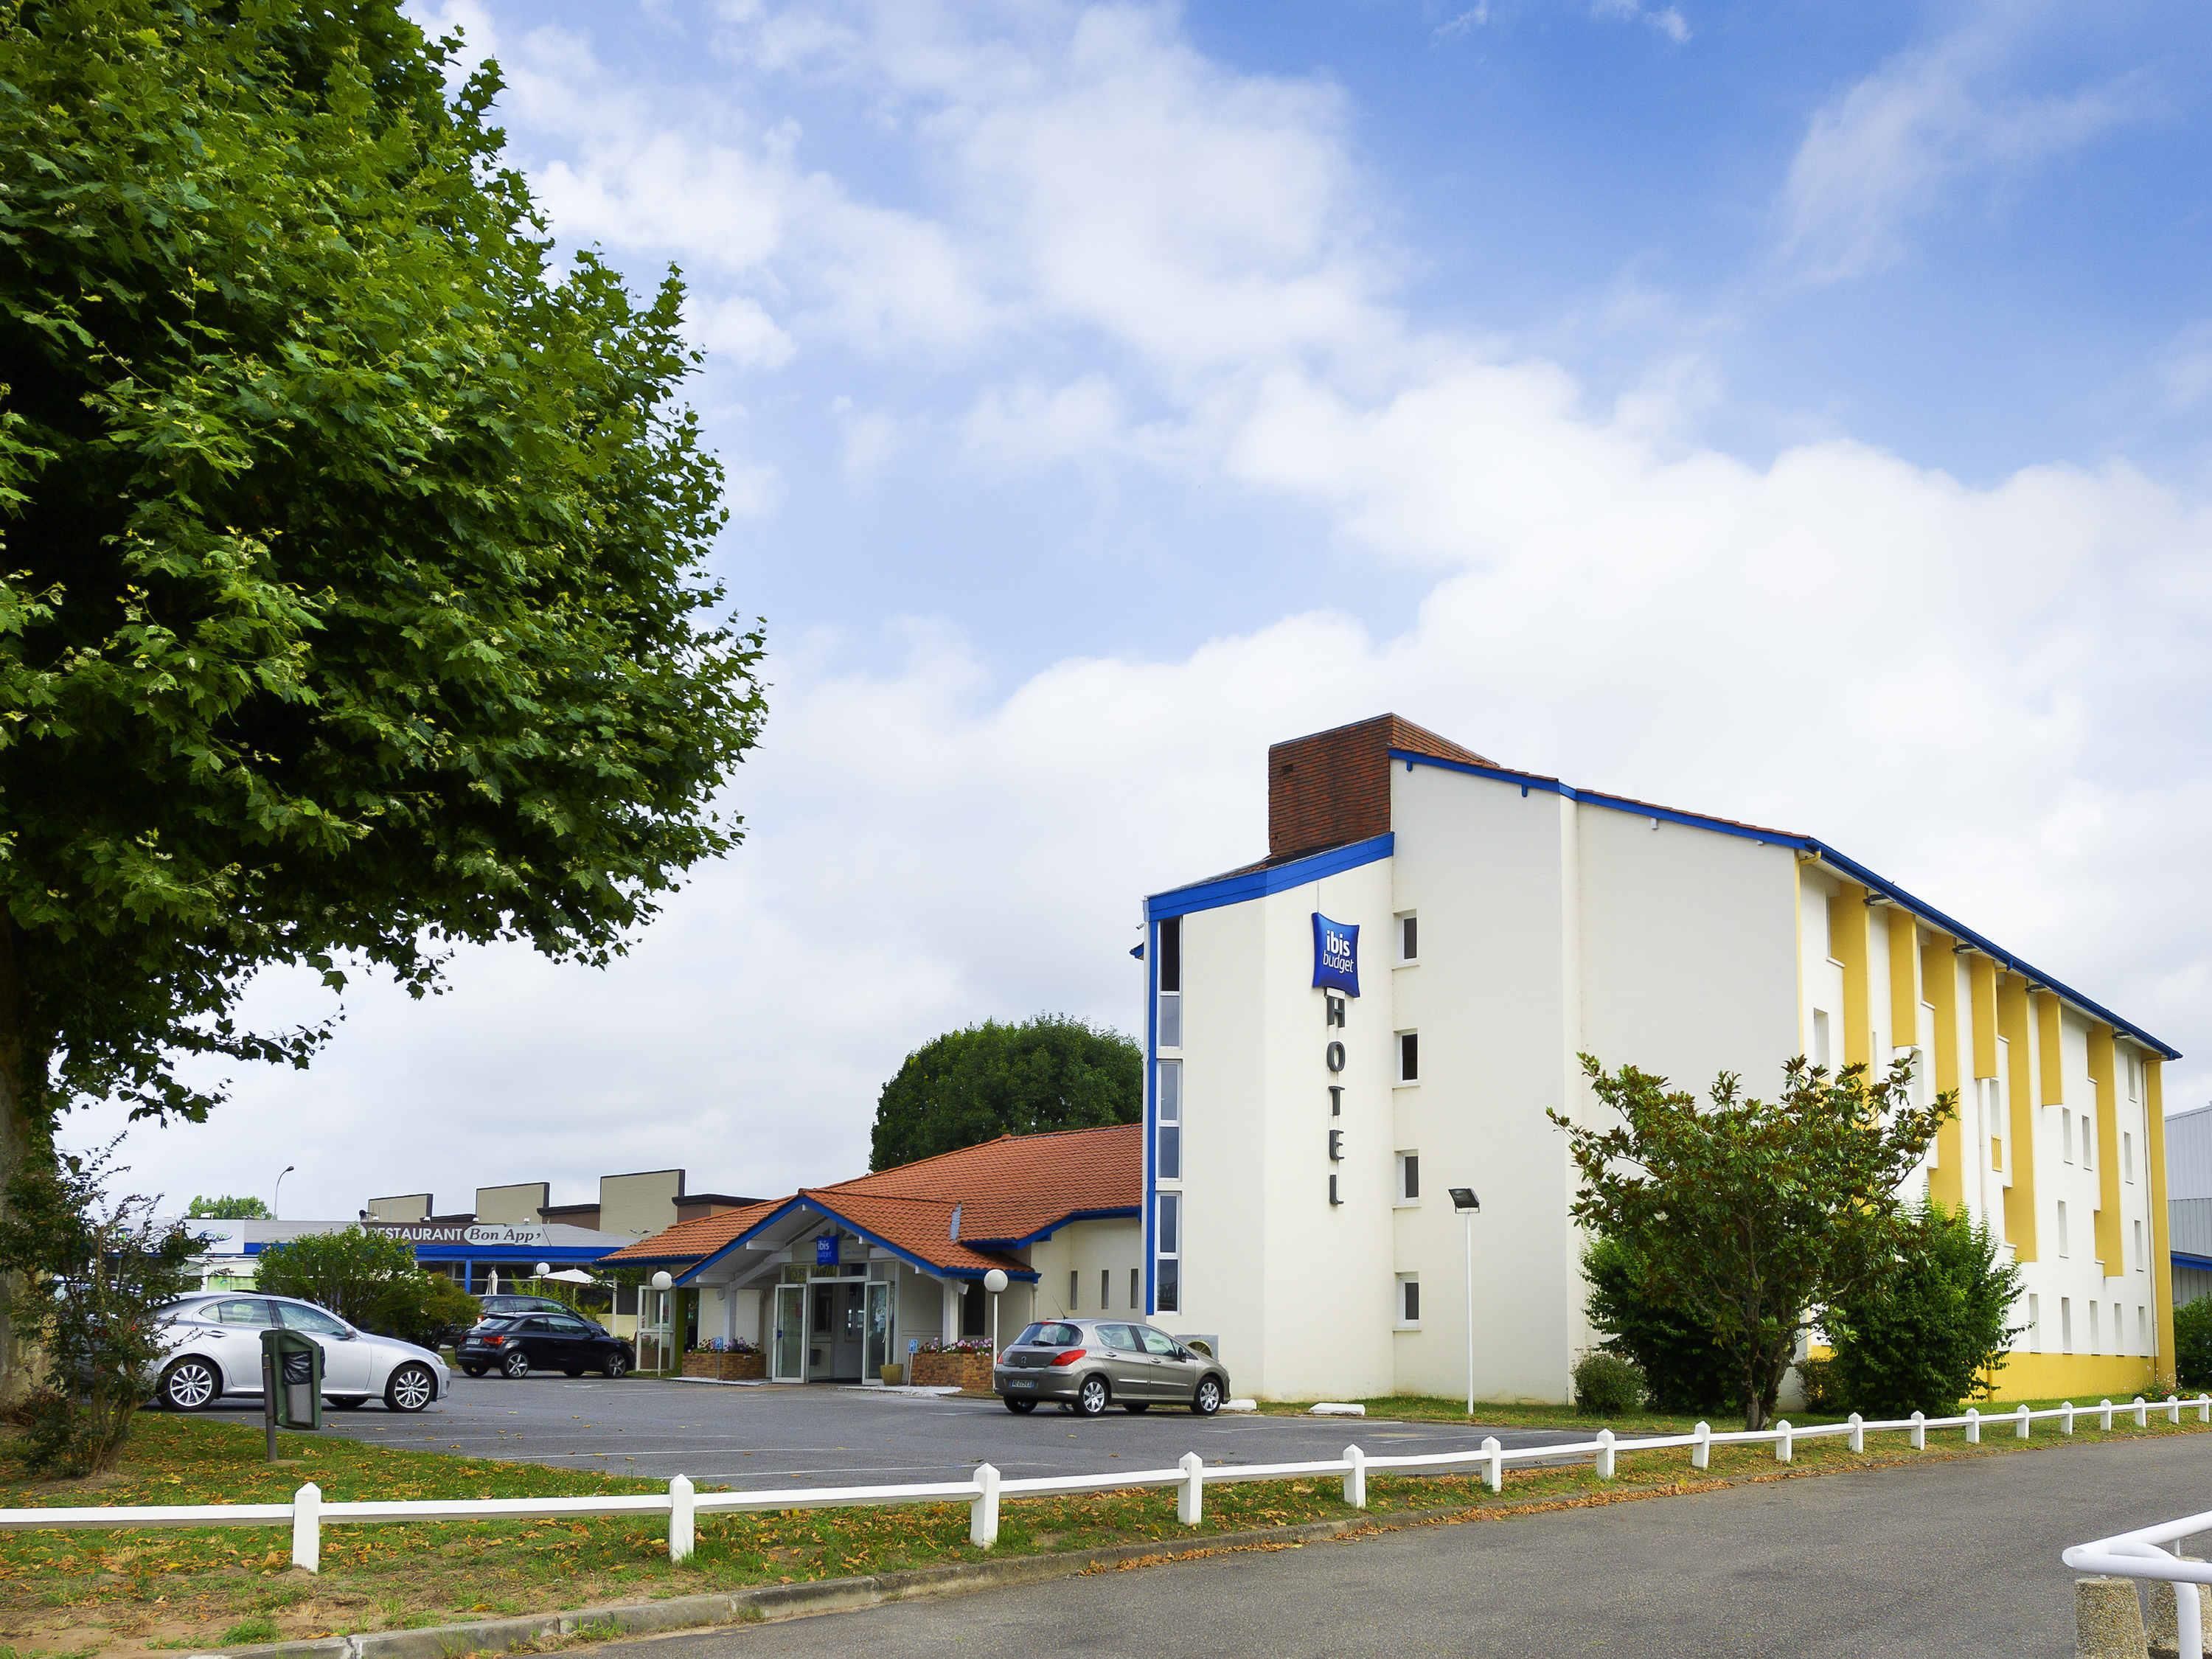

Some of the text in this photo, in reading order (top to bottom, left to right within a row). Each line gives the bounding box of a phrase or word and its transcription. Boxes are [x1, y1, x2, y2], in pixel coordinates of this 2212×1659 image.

[1326, 930, 1350, 956] ibis
[1323, 950, 1354, 973] budget
[1327, 995, 1345, 1205] HOTEL
[469, 1228, 498, 1241] Bon
[818, 1240, 830, 1251] ibis
